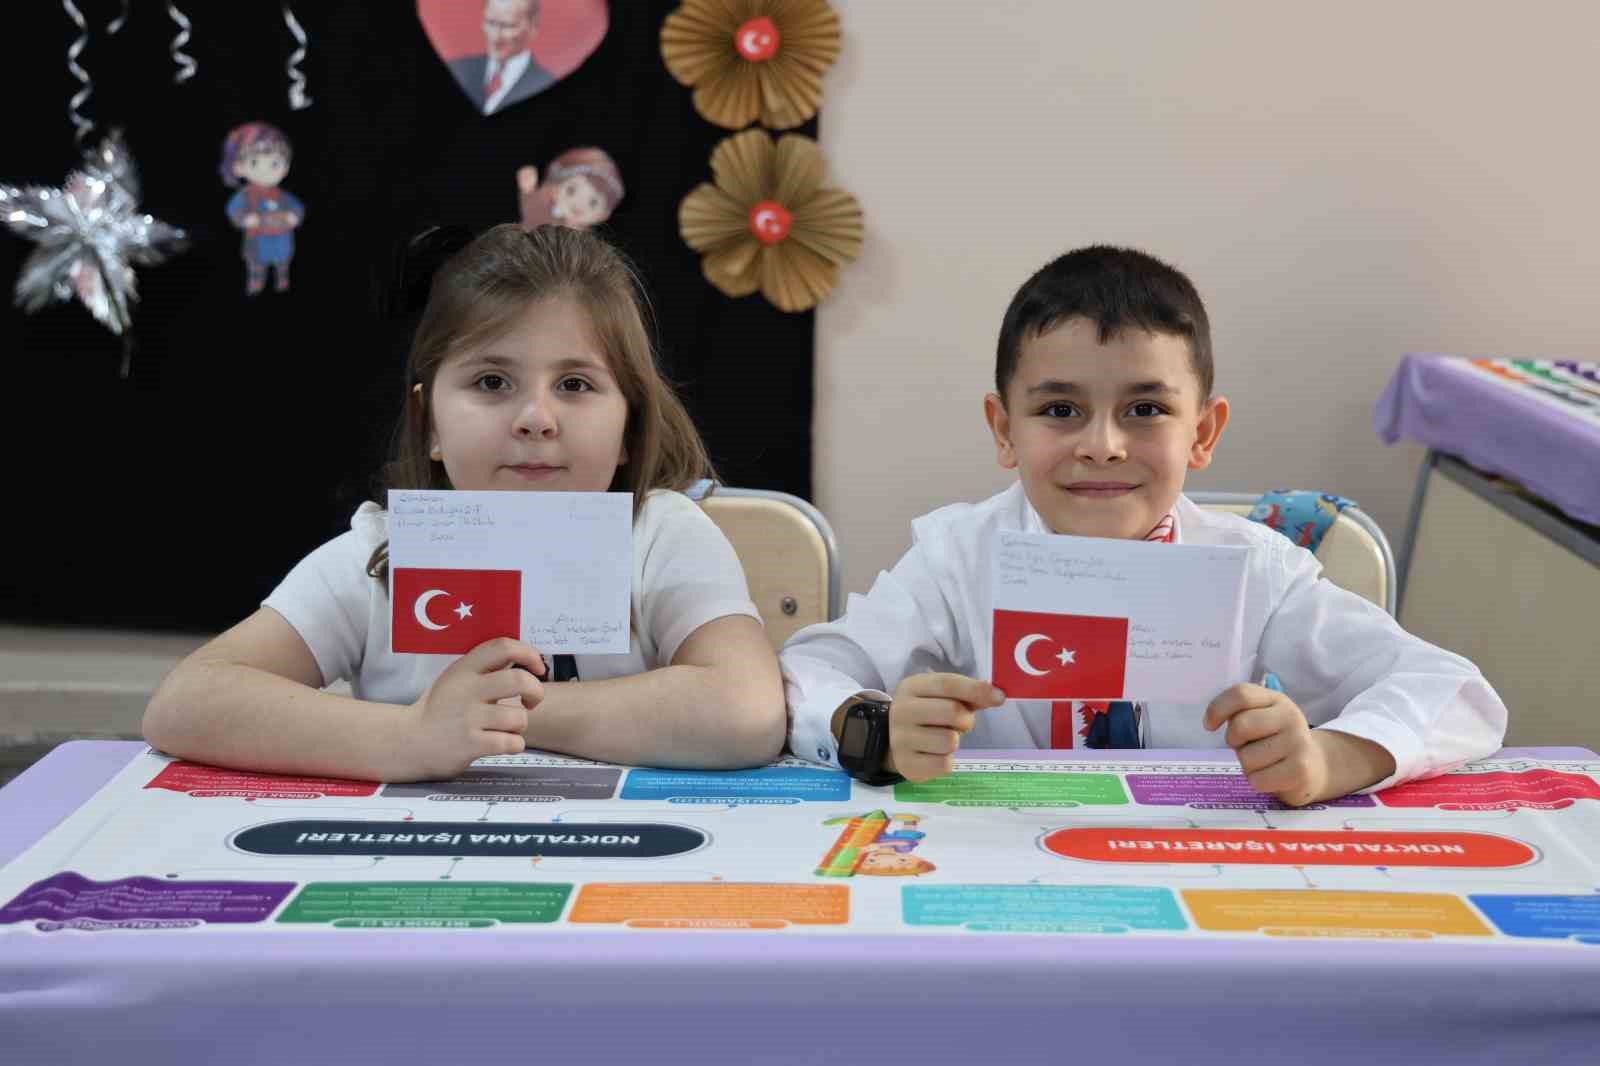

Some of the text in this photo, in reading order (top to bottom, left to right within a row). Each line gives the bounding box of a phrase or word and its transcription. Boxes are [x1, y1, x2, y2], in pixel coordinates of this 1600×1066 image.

[296, 832, 641, 846] NOKTALAMA İŞARETLERİ
[1279, 842, 1465, 854] NOKTALAMA
